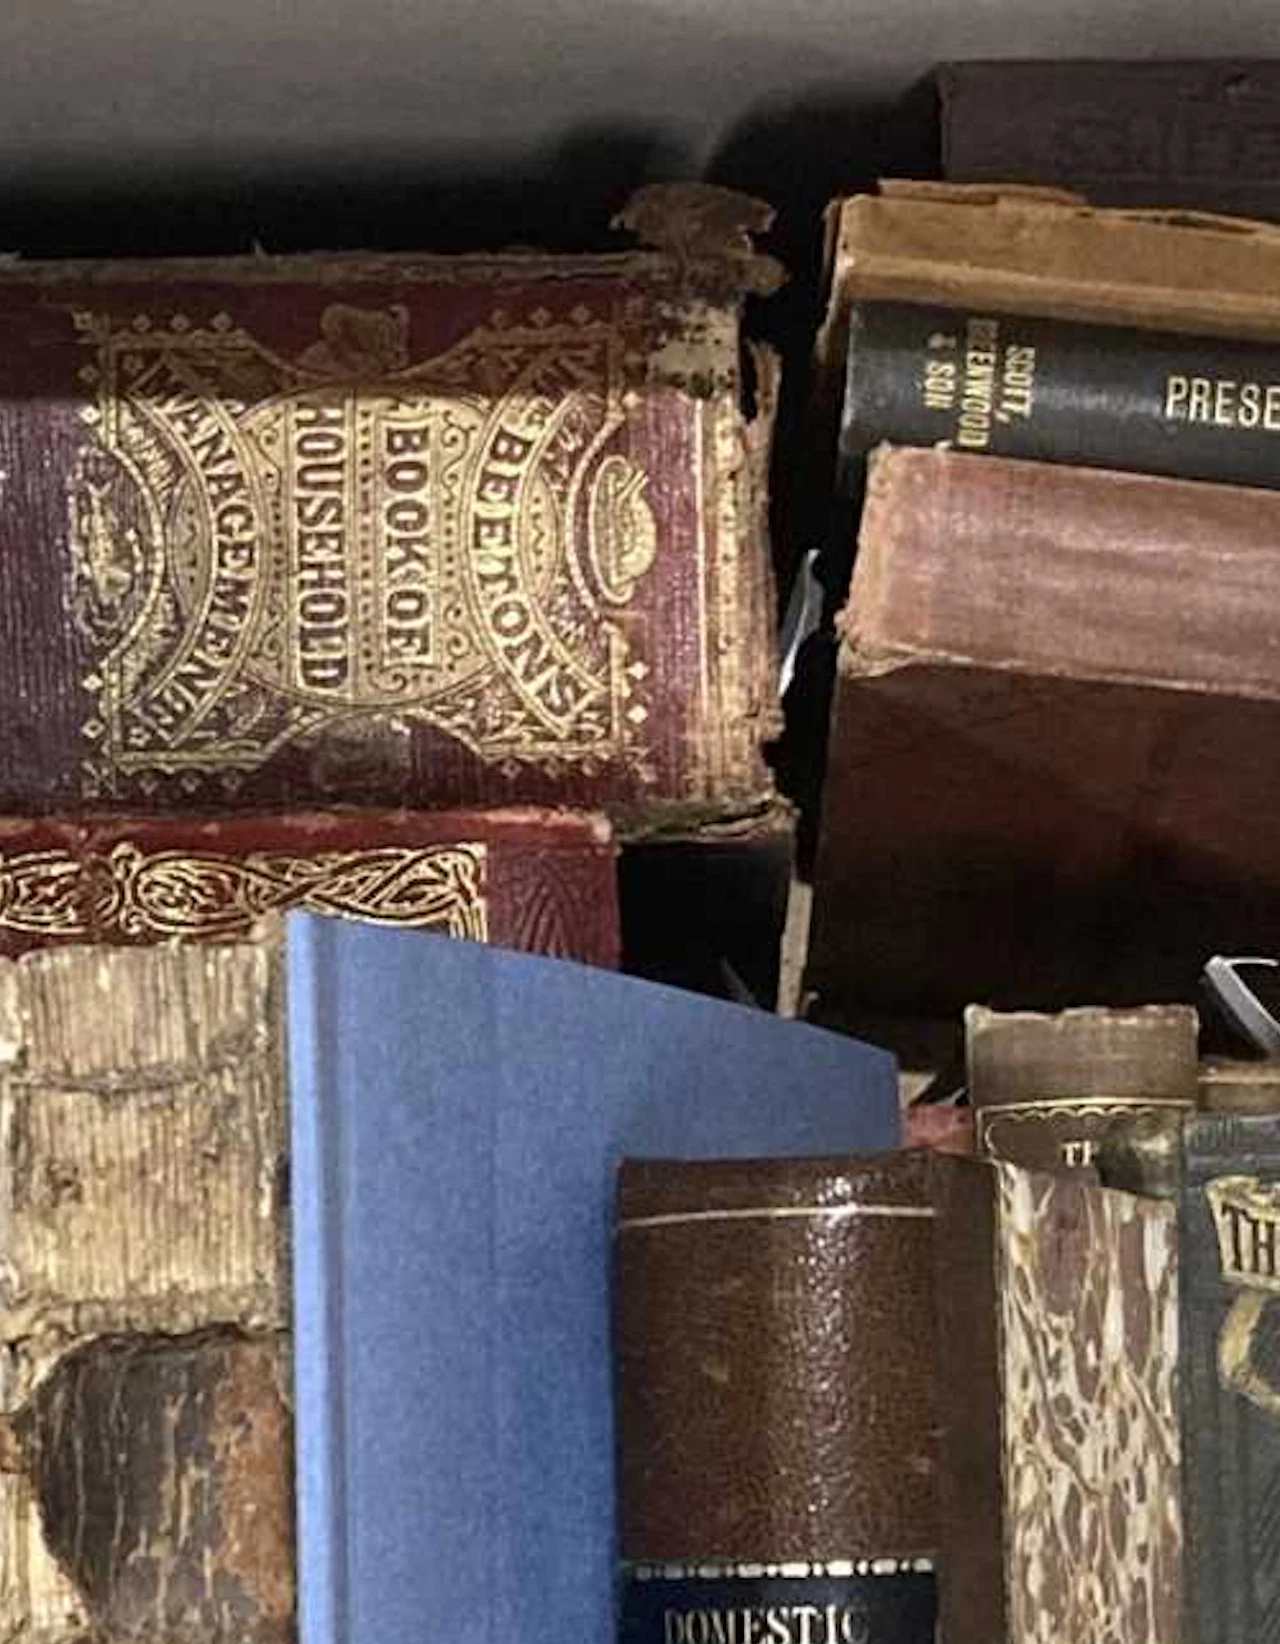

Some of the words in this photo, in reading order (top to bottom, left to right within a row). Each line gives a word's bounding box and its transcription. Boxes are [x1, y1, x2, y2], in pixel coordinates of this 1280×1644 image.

[921, 358, 956, 410] SON
[293, 402, 350, 692] HOUSEHOLD
[384, 424, 432, 576] BOOK
[384, 588, 432, 662] OF
